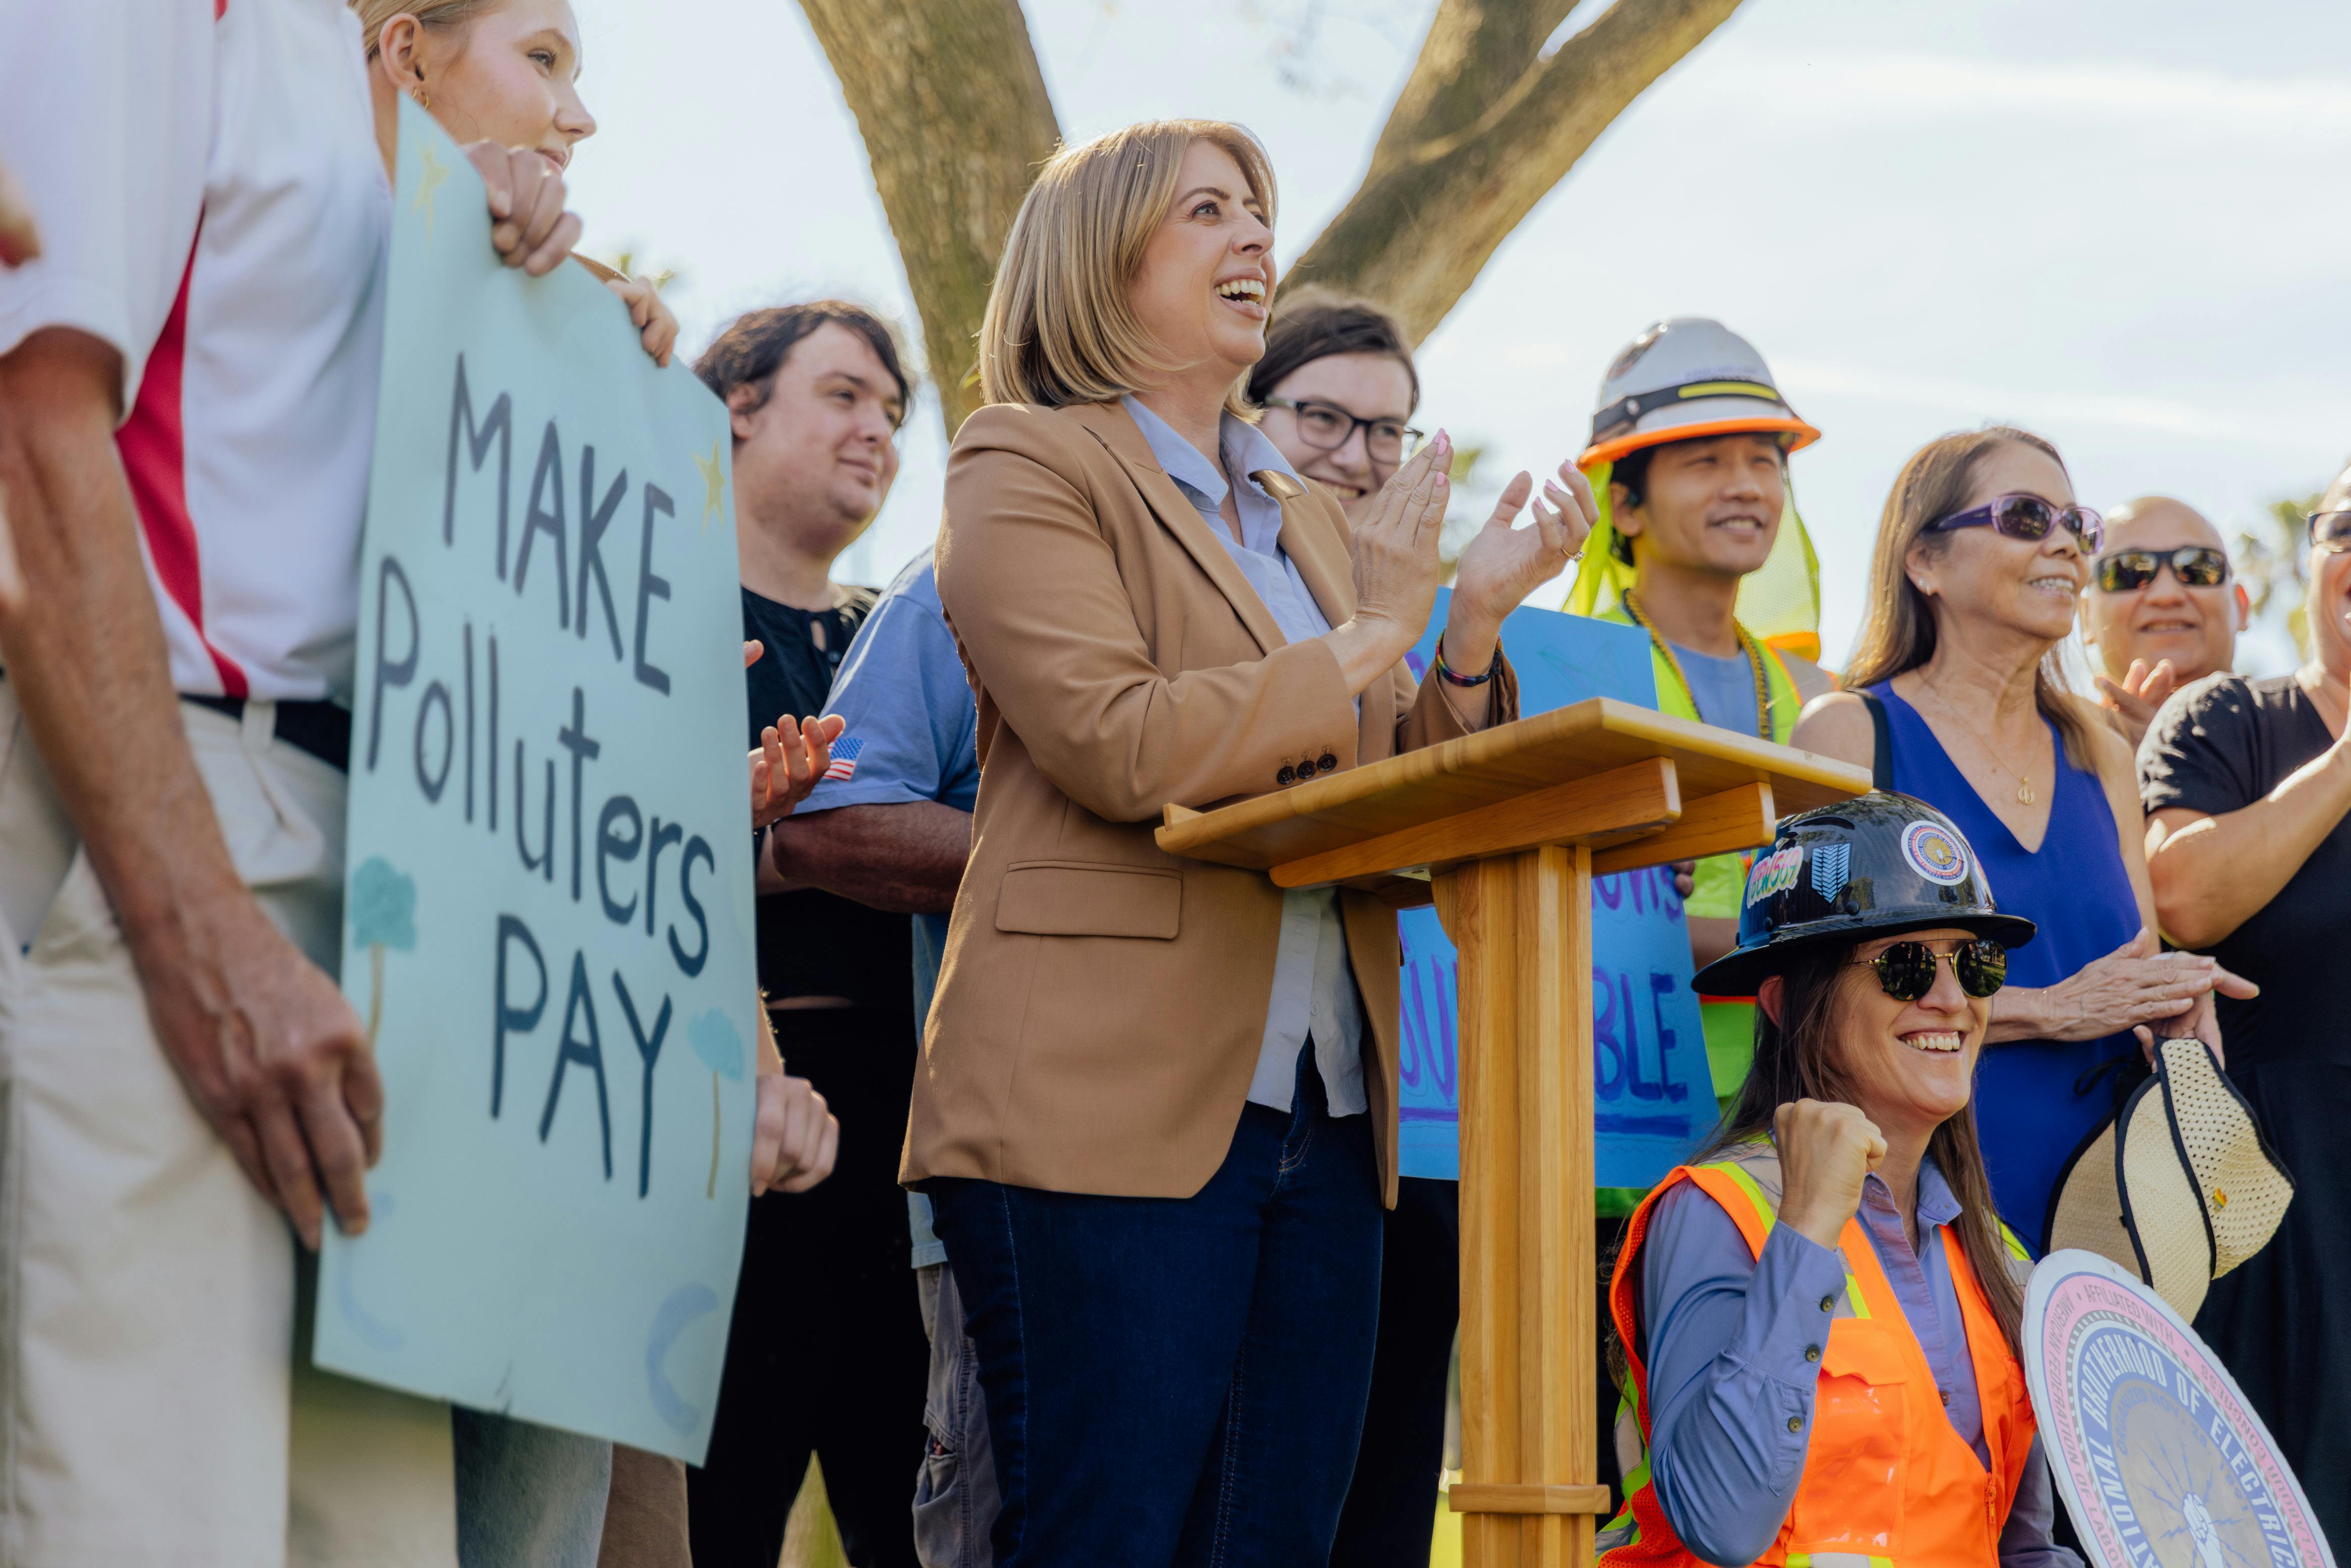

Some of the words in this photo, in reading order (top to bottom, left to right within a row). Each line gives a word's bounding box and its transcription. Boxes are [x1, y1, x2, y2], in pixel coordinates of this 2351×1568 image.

[444, 352, 676, 696] MAKE
[368, 555, 715, 978] Polluters
[491, 912, 673, 1200] PAY
[2048, 1292, 2075, 1355] AMERICAN
[2083, 1284, 2141, 1319] AFFILIATED
[2141, 1307, 2174, 1346] WITH
[2048, 1350, 2081, 1467] FEDERATION
[2081, 1333, 2168, 1431] BROTHERHOOD
[2176, 1371, 2200, 1415] OF
[2210, 1414, 2296, 1568] ELECTRIC
[2075, 1472, 2093, 1500] OF
[2088, 1505, 2123, 1568] LABO
